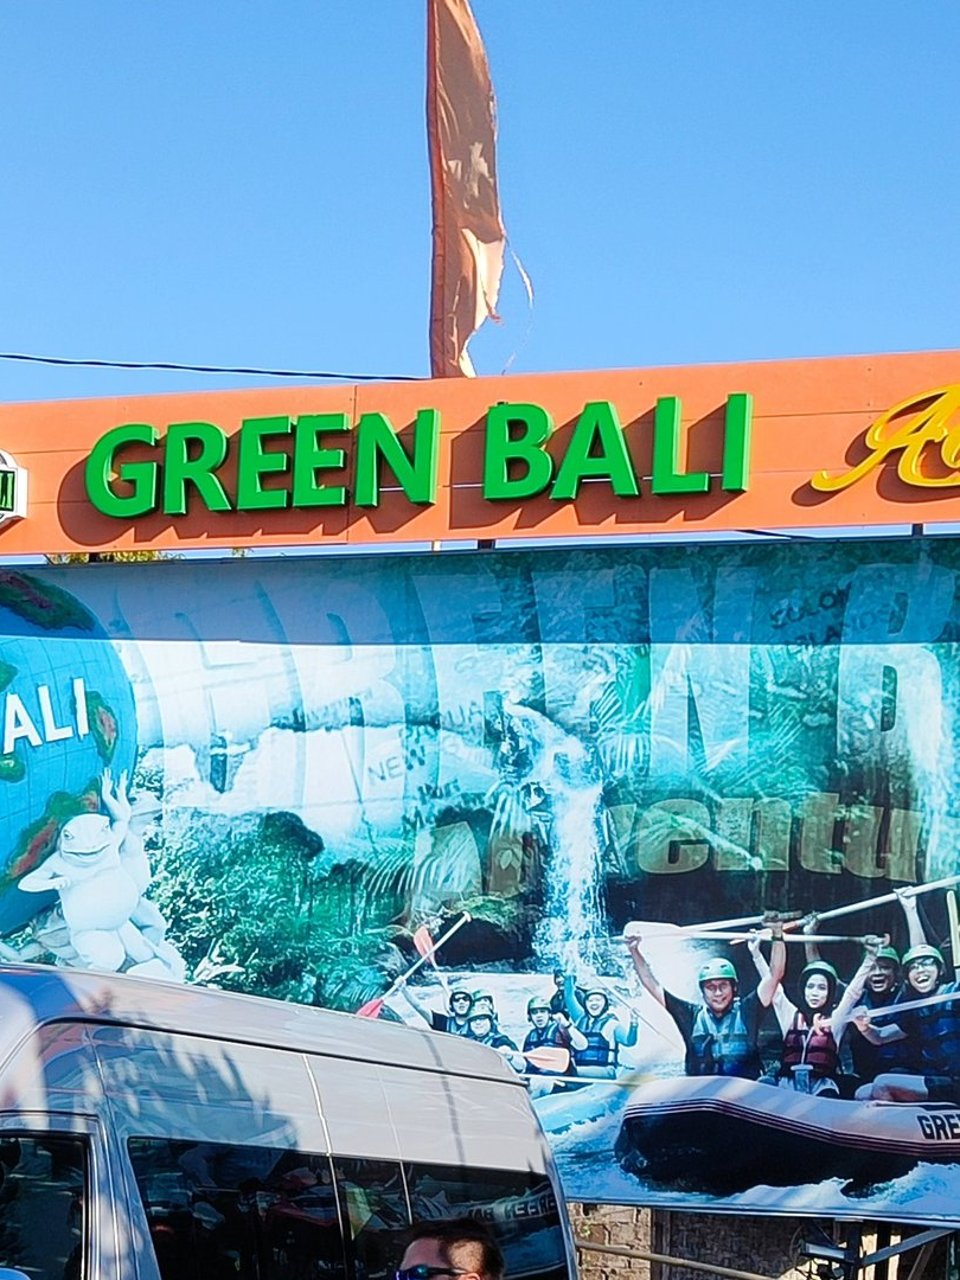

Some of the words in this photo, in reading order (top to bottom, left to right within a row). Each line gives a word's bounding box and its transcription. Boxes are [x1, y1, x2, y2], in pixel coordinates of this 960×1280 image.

[84, 408, 440, 519] GREEN
[484, 392, 753, 502] BALI
[916, 1112, 960, 1140] GRE
